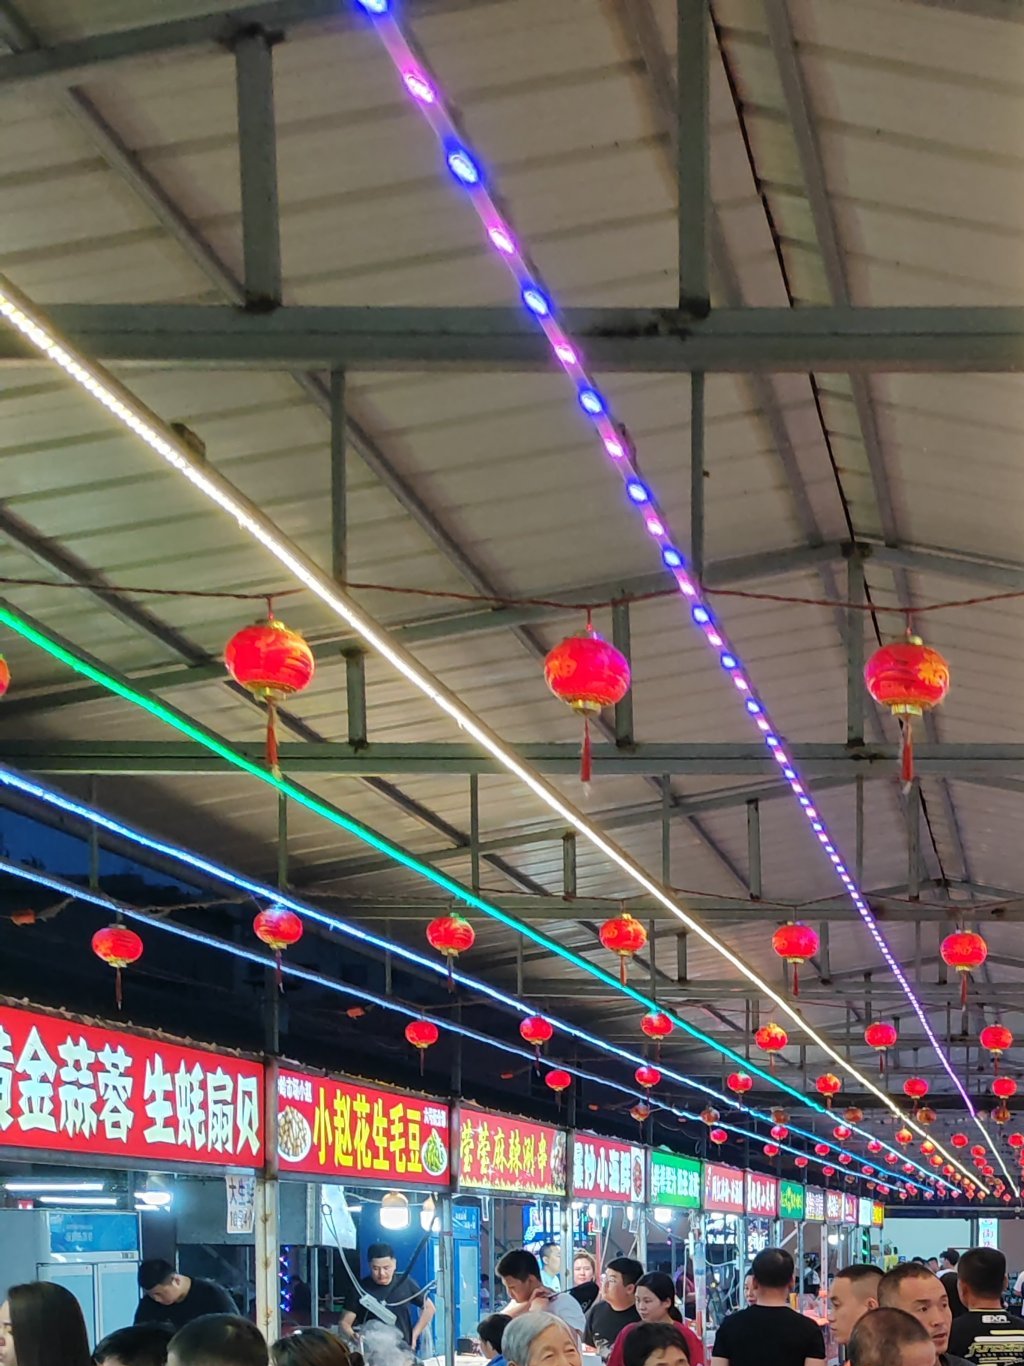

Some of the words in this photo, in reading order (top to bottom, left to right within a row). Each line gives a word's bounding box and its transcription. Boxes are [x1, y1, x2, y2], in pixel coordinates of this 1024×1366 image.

[143, 1052, 260, 1156] 生蚝扇贝
[313, 1087, 422, 1173] 小赵花生毛豆
